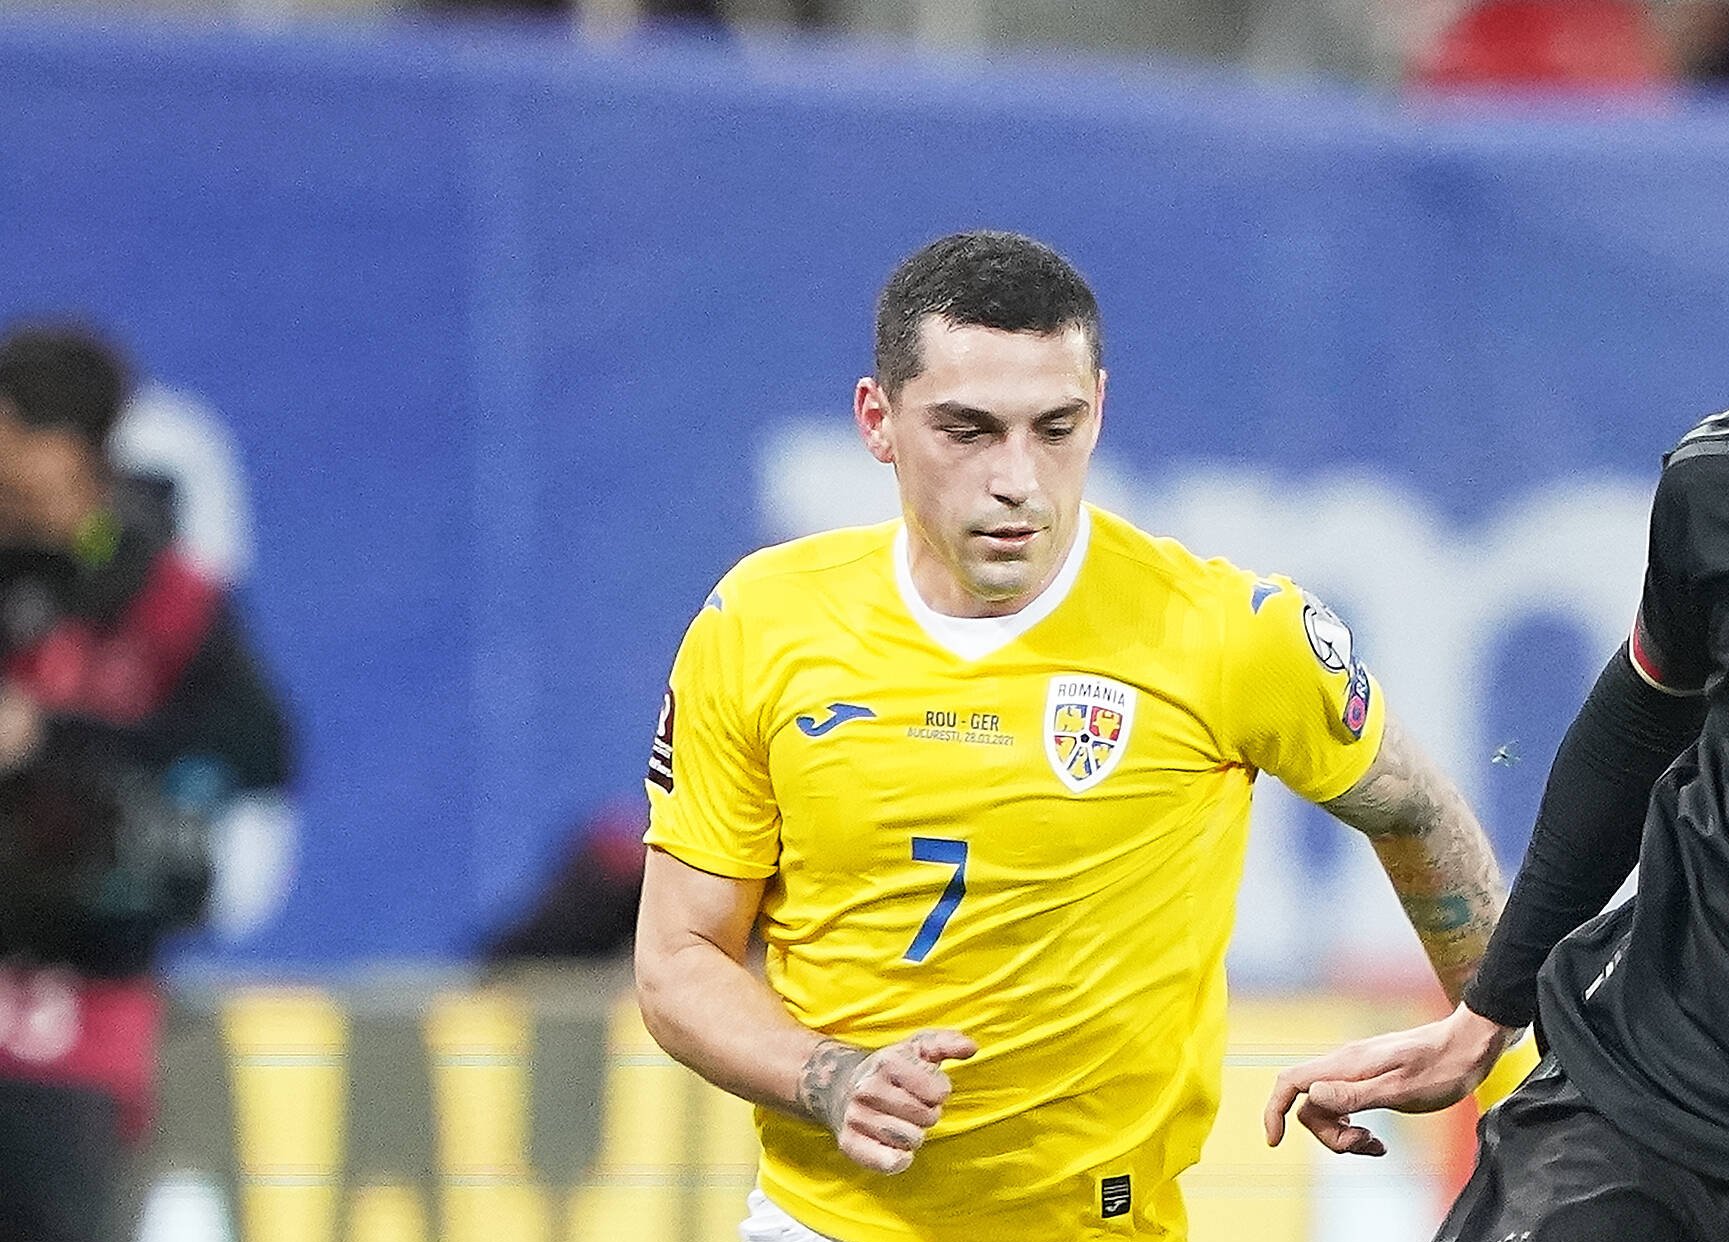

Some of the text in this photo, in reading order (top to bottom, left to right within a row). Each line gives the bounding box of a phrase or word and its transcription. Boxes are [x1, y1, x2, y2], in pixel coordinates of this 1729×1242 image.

[1057, 680, 1126, 706] ROMÂNIA
[925, 711, 957, 728] ROU
[970, 712, 1000, 732] GER
[901, 837, 969, 962] 7
